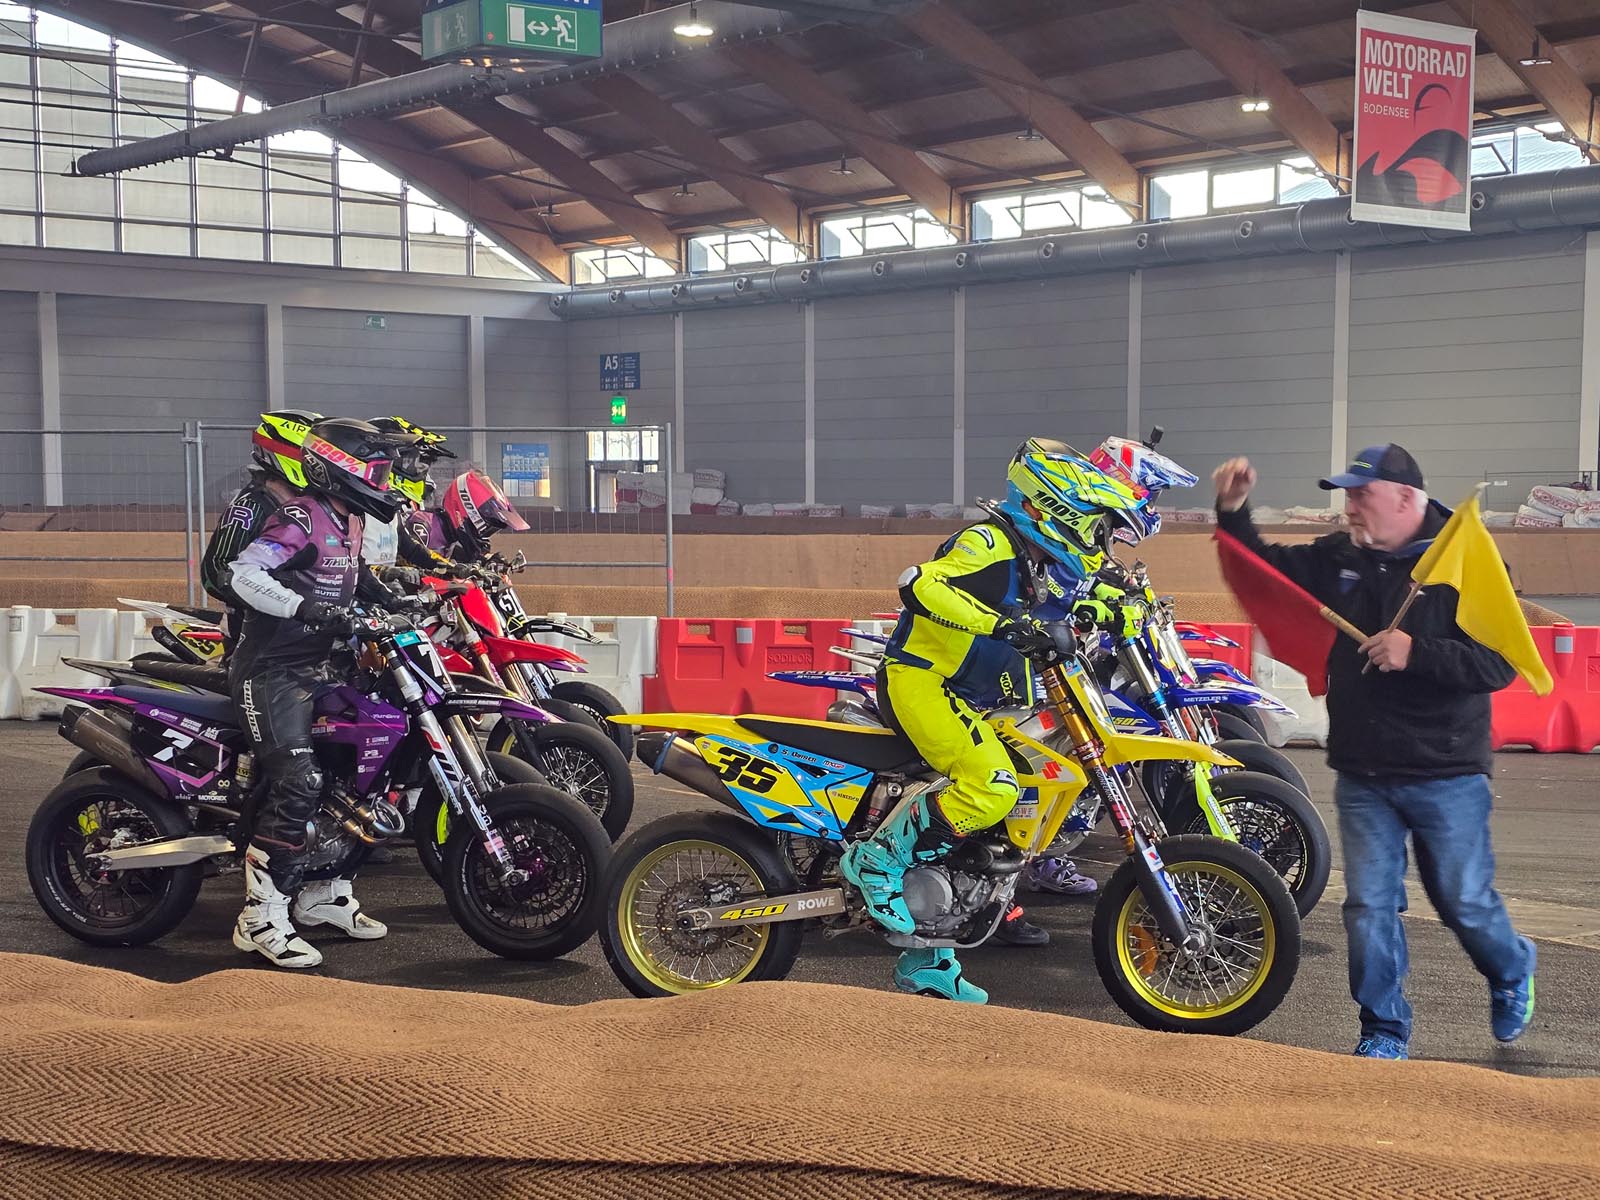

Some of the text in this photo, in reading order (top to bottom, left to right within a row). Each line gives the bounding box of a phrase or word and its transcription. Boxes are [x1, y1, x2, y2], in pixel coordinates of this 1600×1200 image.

[1365, 37, 1467, 78] MOTORRAD
[1363, 67, 1413, 100] WELT
[1363, 102, 1410, 119] BODENSEE
[604, 355, 618, 370] A5
[1031, 489, 1080, 526] 100%
[718, 746, 784, 794] 35
[719, 903, 788, 920] 450
[797, 896, 835, 911] ROWE
